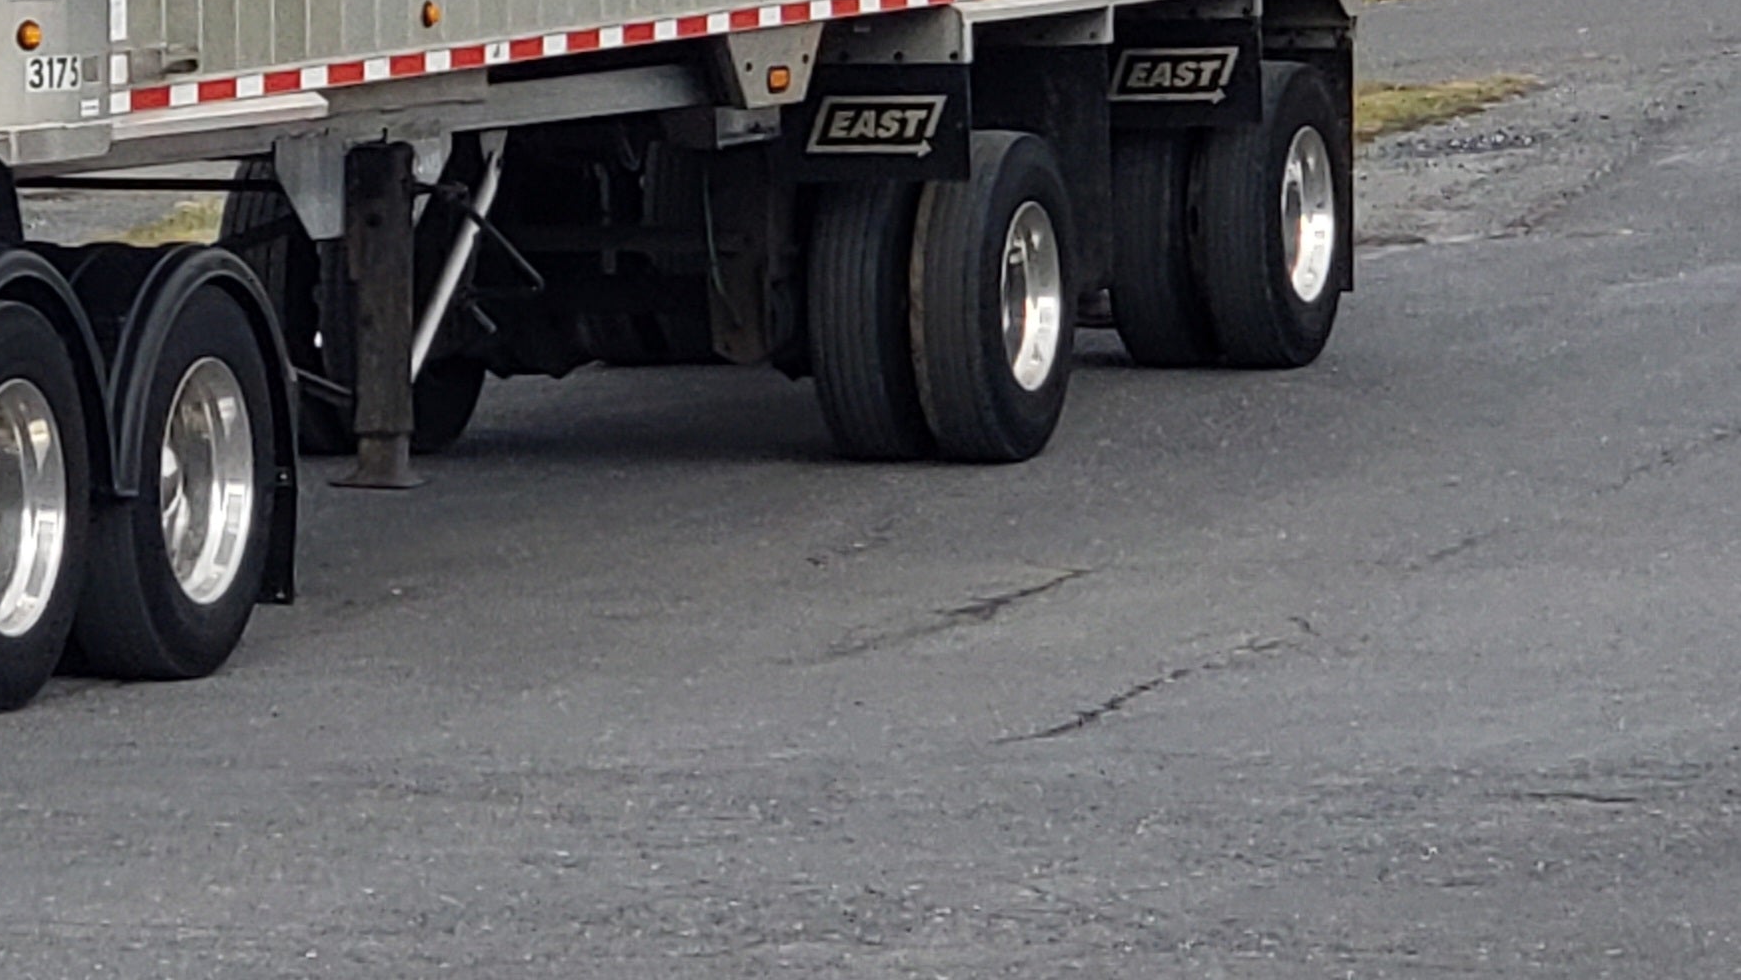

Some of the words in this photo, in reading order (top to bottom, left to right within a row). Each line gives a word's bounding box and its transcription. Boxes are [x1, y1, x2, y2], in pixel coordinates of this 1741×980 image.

[28, 56, 79, 89] 3175
[1125, 59, 1222, 87] EAST
[827, 109, 929, 139] EAST
